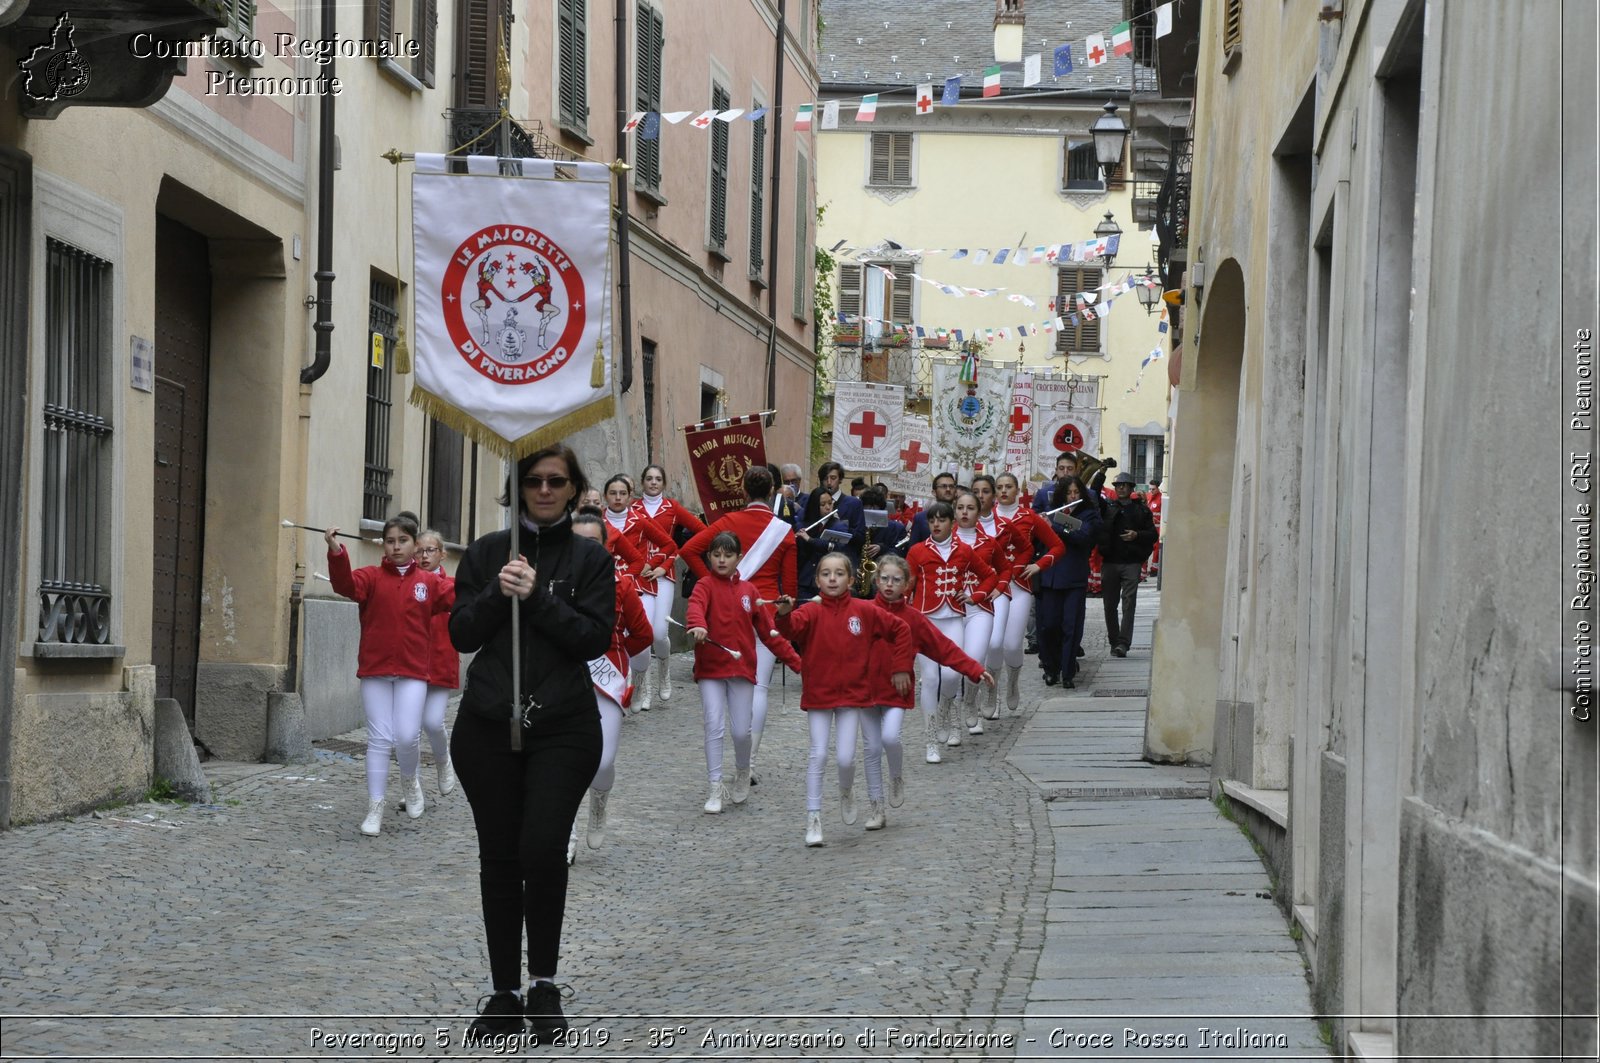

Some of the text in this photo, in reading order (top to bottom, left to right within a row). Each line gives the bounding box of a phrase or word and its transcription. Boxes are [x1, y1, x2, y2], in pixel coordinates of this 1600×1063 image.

[457, 228, 572, 272] LE MAJORETTE
[461, 340, 567, 380] DI PEVERAGNO
[1036, 383, 1053, 392] CROCE
[693, 434, 760, 458] BANDA MUSICALE
[844, 460, 887, 469] PEVERAGNO
[709, 498, 744, 510] DI PEVER
